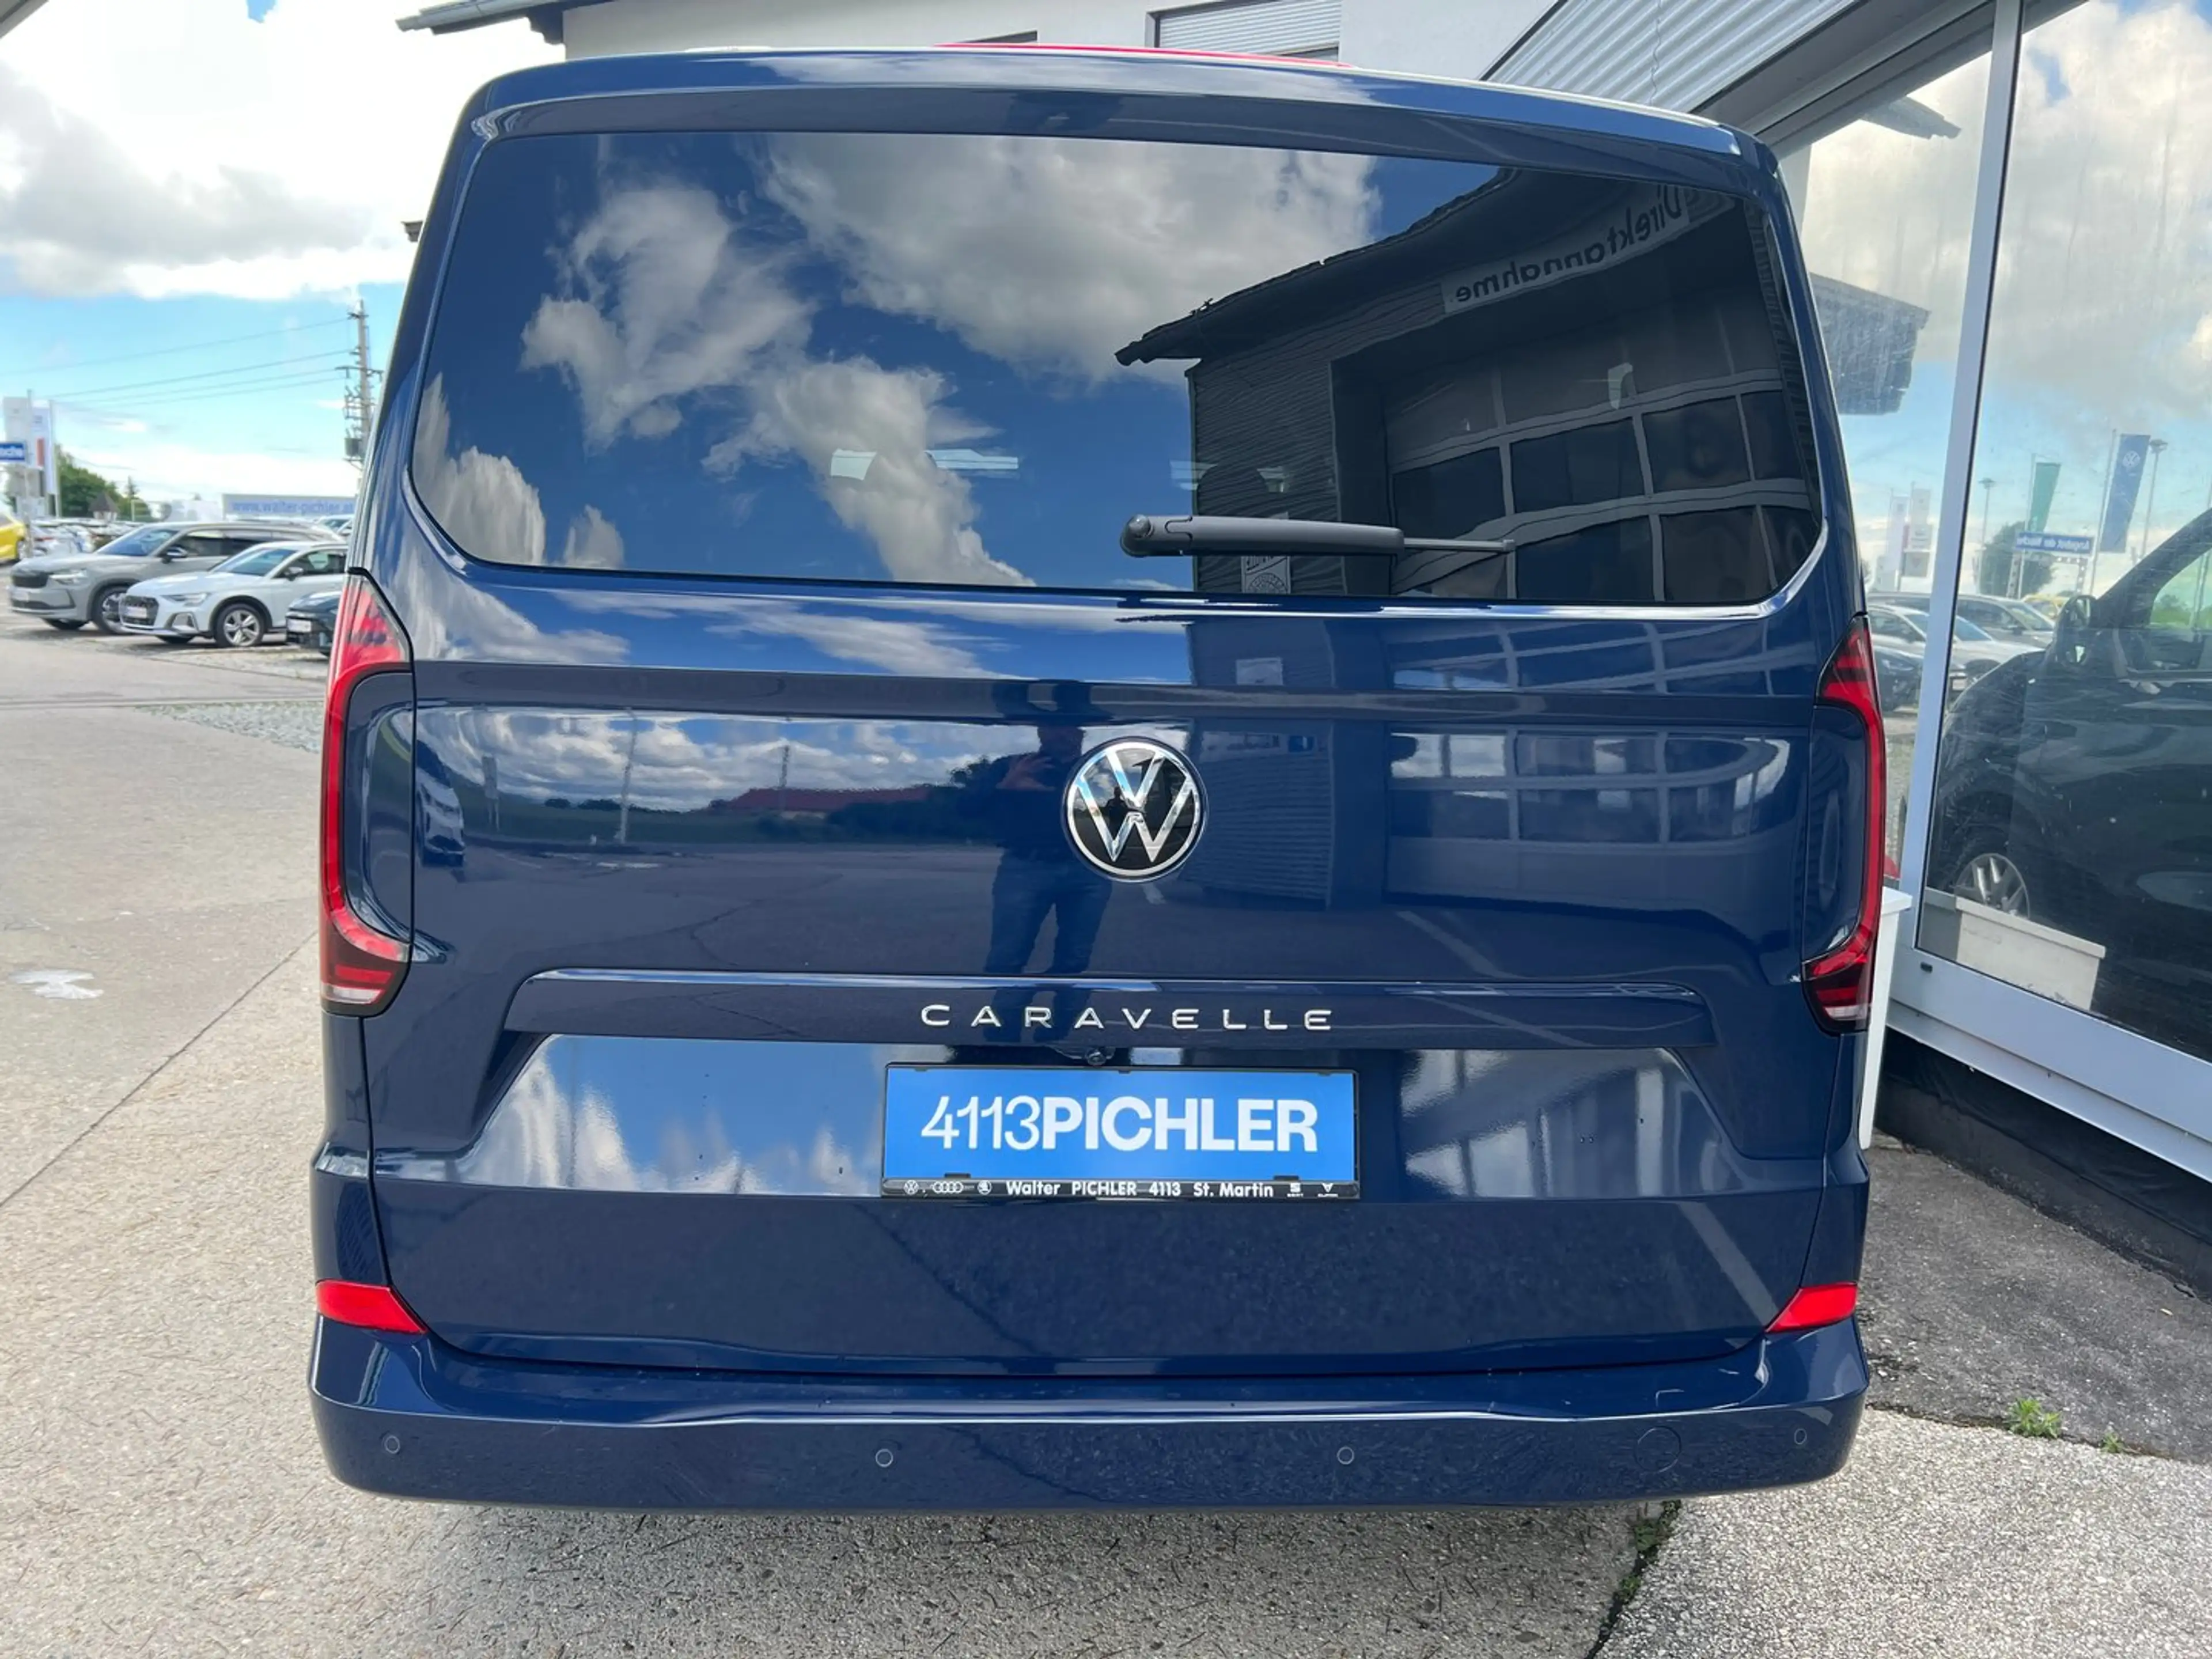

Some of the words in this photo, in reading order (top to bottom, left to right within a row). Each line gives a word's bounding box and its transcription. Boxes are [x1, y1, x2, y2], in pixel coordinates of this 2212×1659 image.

[921, 1004, 1332, 1030] CARAVELLE
[1006, 1180, 1060, 1195] Walter
[1071, 1181, 1137, 1196] PICHLER
[1149, 1181, 1181, 1196] 4113
[1193, 1181, 1214, 1197] St.
[1219, 1181, 1273, 1198] Martin
